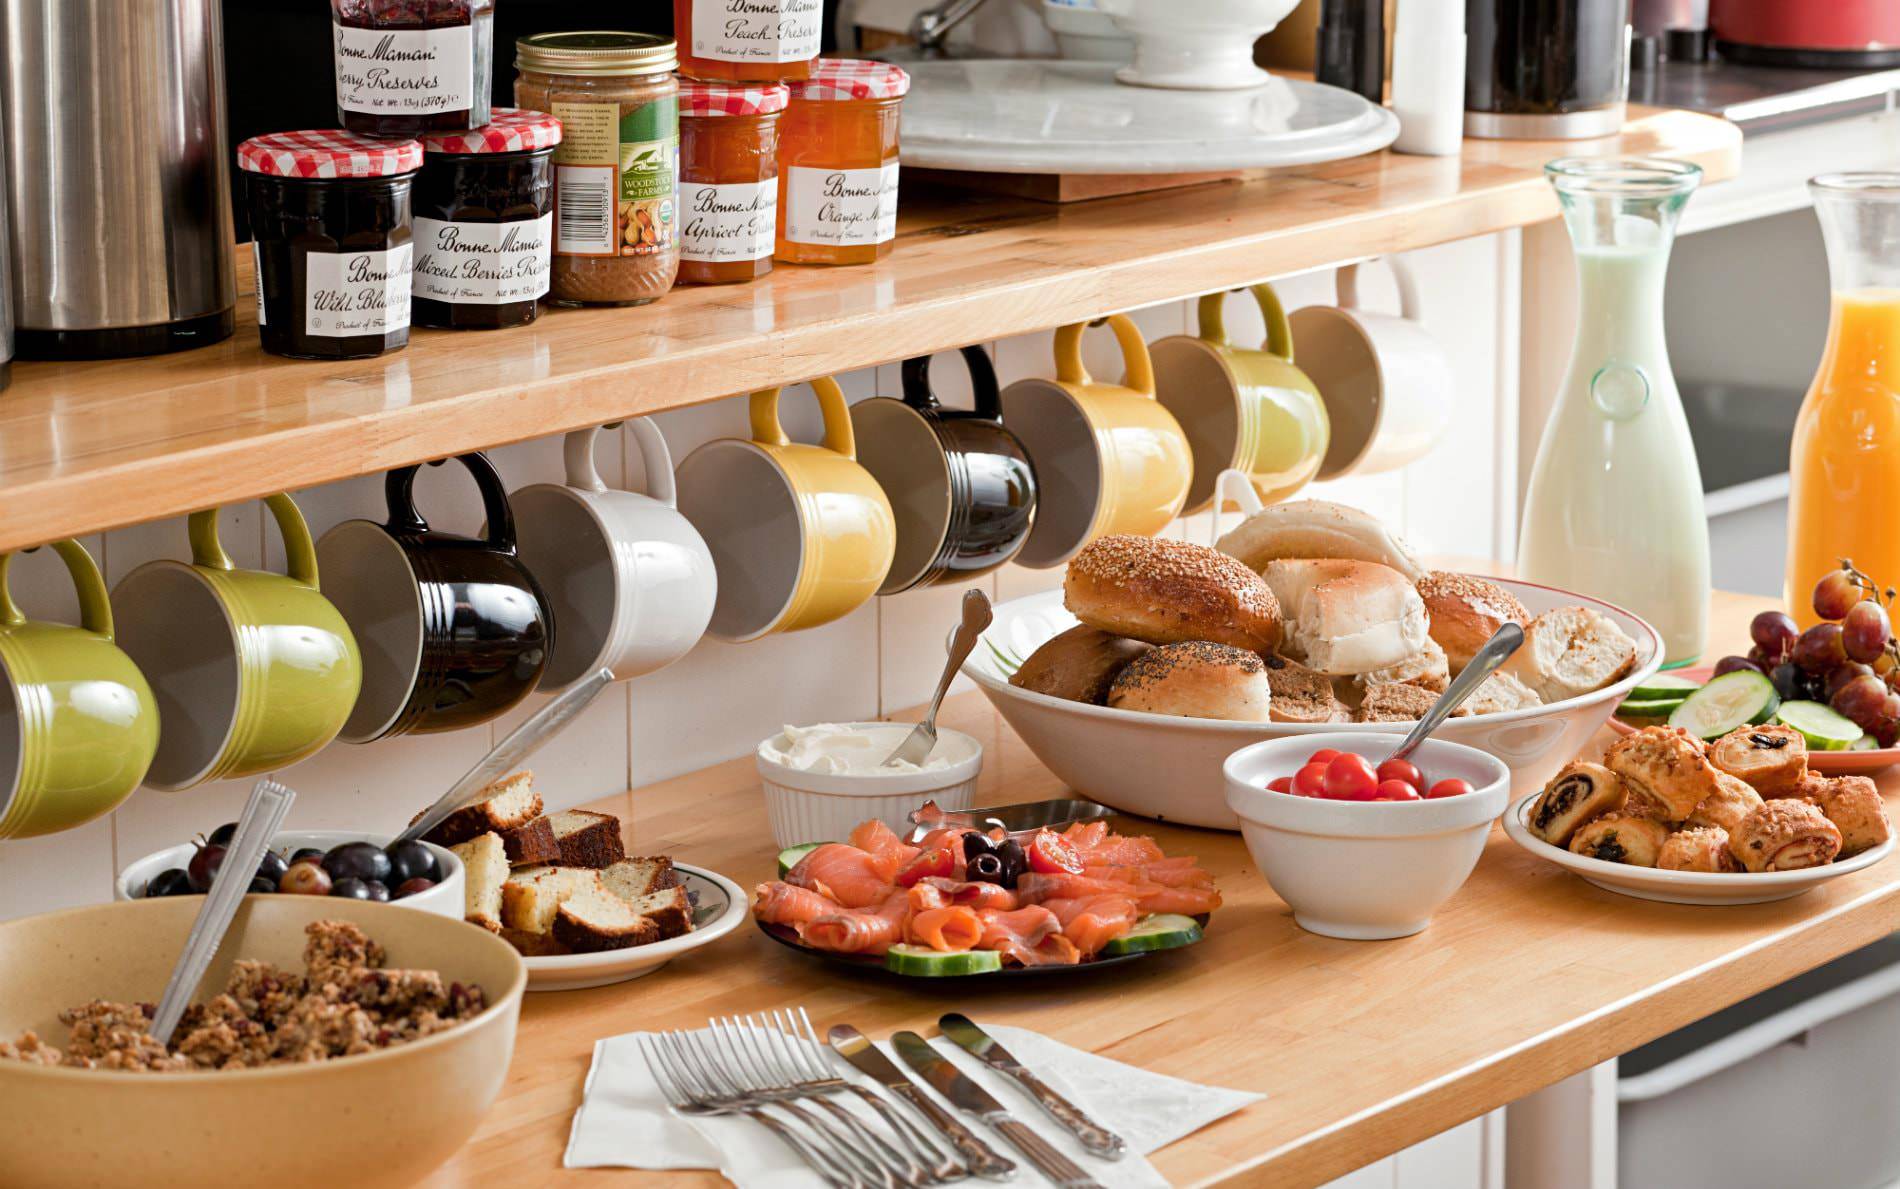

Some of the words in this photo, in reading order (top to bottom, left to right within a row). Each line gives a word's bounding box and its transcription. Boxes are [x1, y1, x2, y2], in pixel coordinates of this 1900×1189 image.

[724, 19, 772, 40] Peach
[368, 34, 436, 61] Maman
[715, 45, 738, 55] Product
[740, 47, 748, 58] of
[367, 67, 440, 90] Preserves
[823, 173, 871, 198] Bonne
[693, 187, 744, 213] Bonne
[817, 202, 864, 229] Orange
[437, 226, 492, 253] Bonne
[684, 217, 745, 243] Apricot
[707, 247, 715, 258] of
[414, 253, 458, 278] Mixed
[461, 258, 514, 280] Berries
[313, 289, 352, 312] Wild
[426, 284, 449, 295] Product
[450, 286, 459, 299] of
[460, 288, 483, 297] France
[335, 320, 360, 329] Product
[362, 318, 370, 331] of
